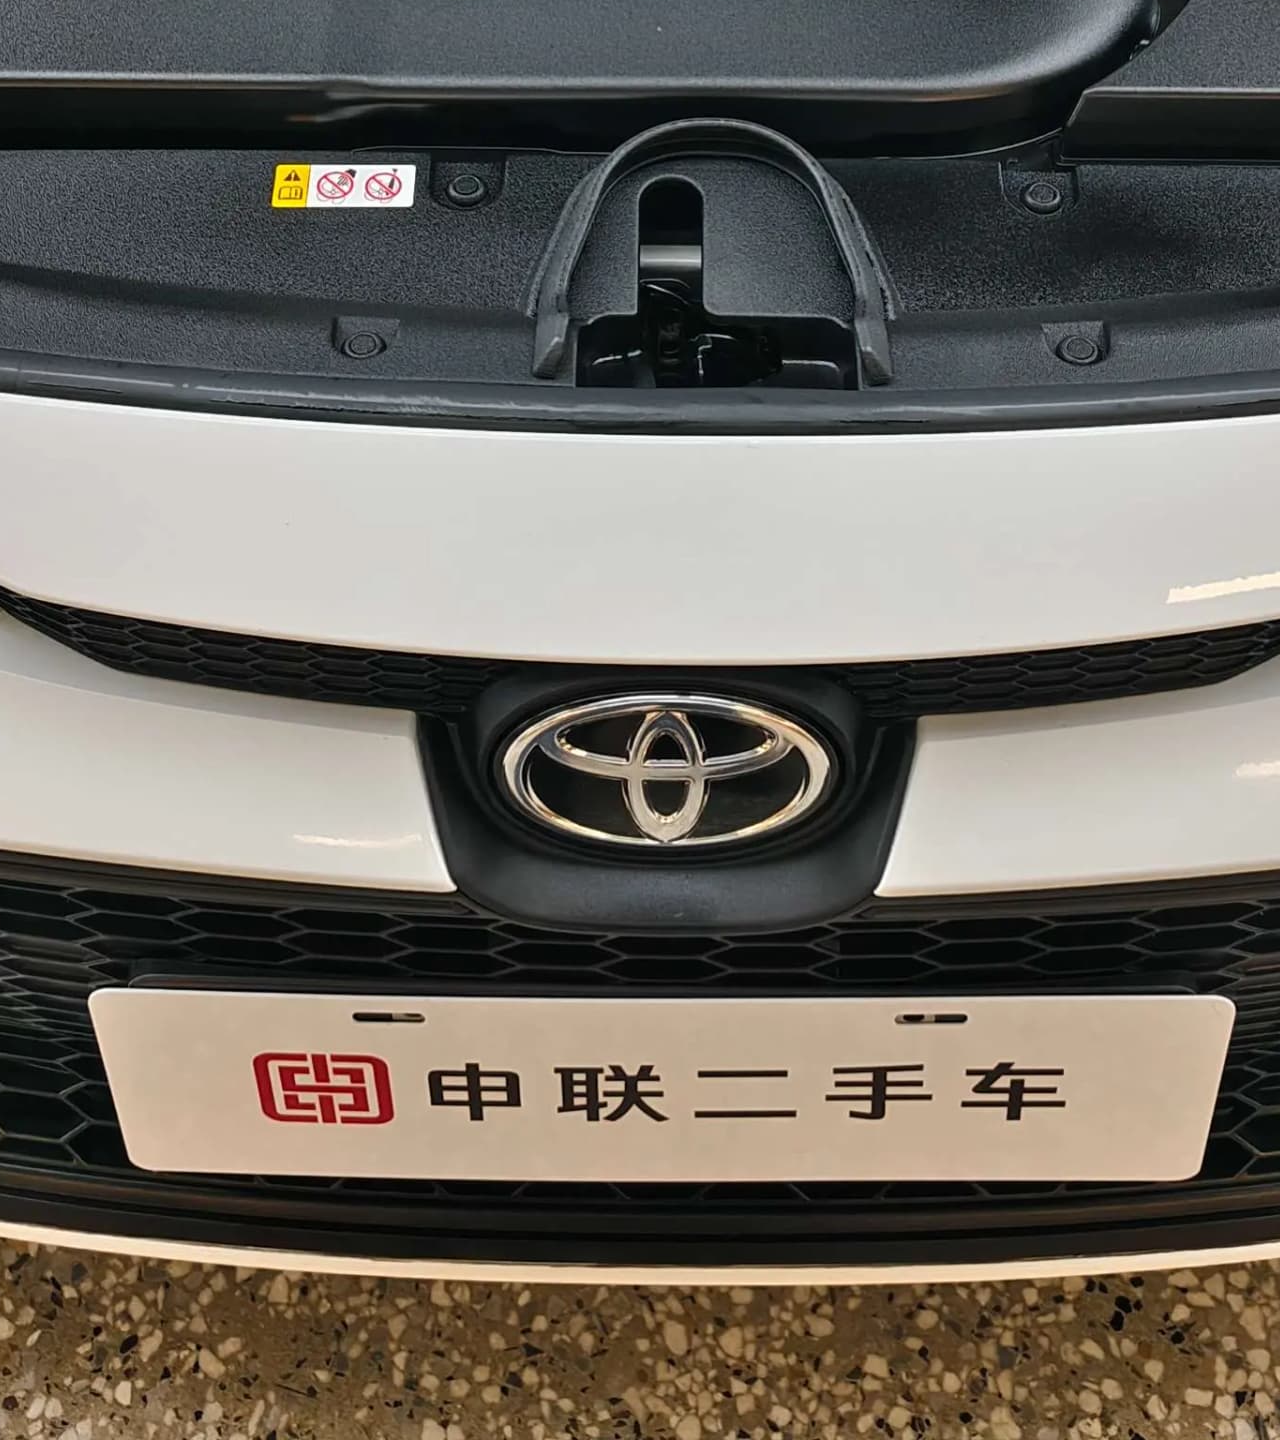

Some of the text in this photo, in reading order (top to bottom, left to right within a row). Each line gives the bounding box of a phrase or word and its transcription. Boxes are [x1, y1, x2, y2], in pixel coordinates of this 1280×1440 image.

[428, 1063, 1067, 1123] 申联二手车
